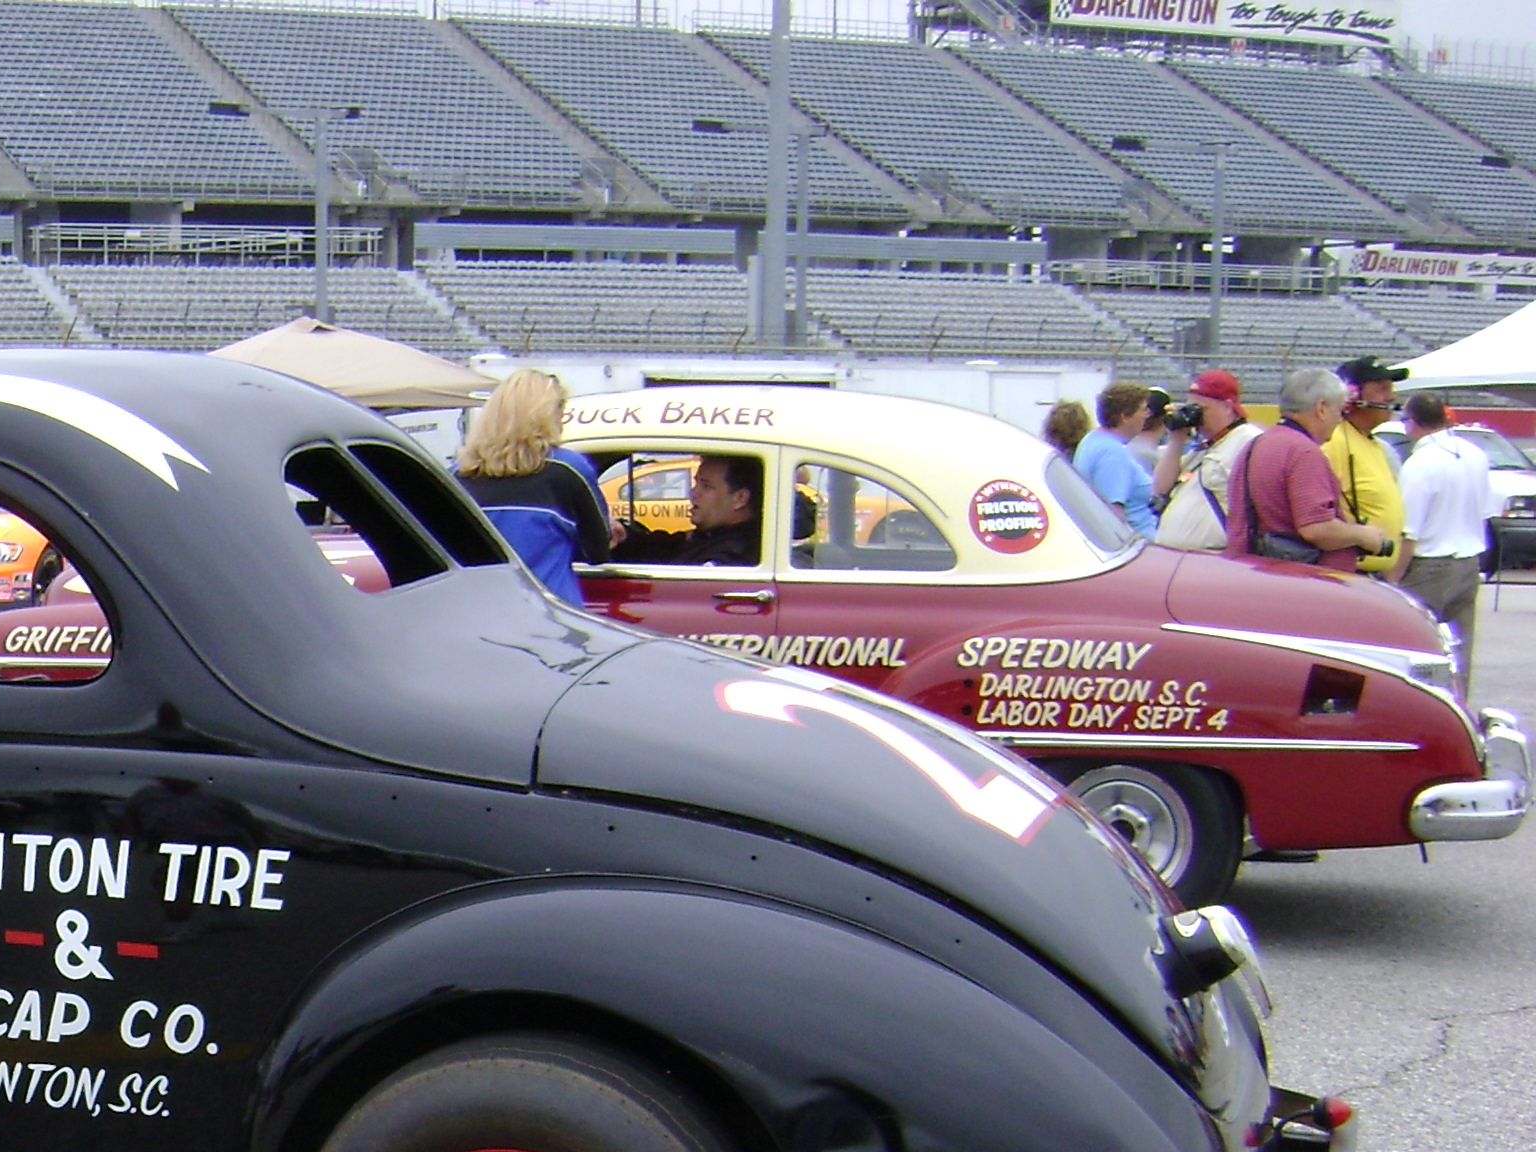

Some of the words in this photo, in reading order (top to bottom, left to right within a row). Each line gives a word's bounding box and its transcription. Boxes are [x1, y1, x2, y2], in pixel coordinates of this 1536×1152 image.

[1227, 2, 1260, 20] too
[1265, 3, 1318, 34] tough
[1323, 8, 1345, 27] to
[1349, 10, 1396, 30] tame
[1361, 250, 1459, 276] DARLINGTON
[561, 406, 641, 425] BUCK
[660, 400, 775, 426] BAKER
[611, 503, 648, 518] READ
[652, 504, 671, 518] ON
[976, 501, 1039, 515] FRICTION
[978, 517, 1044, 532] PROOFING
[4, 625, 112, 654] GRIFFI
[678, 634, 906, 667] TERNATIONAL
[957, 637, 1152, 671] SPEEDWAY
[976, 700, 1061, 727] LABOR
[1067, 703, 1129, 731] DAY,
[1133, 706, 1201, 731] SEPT.
[1207, 709, 1229, 731] 4
[159, 842, 291, 911] TIRE
[54, 909, 114, 980] &
[120, 1000, 219, 1055] CO.
[107, 1072, 169, 1117] S.C.
